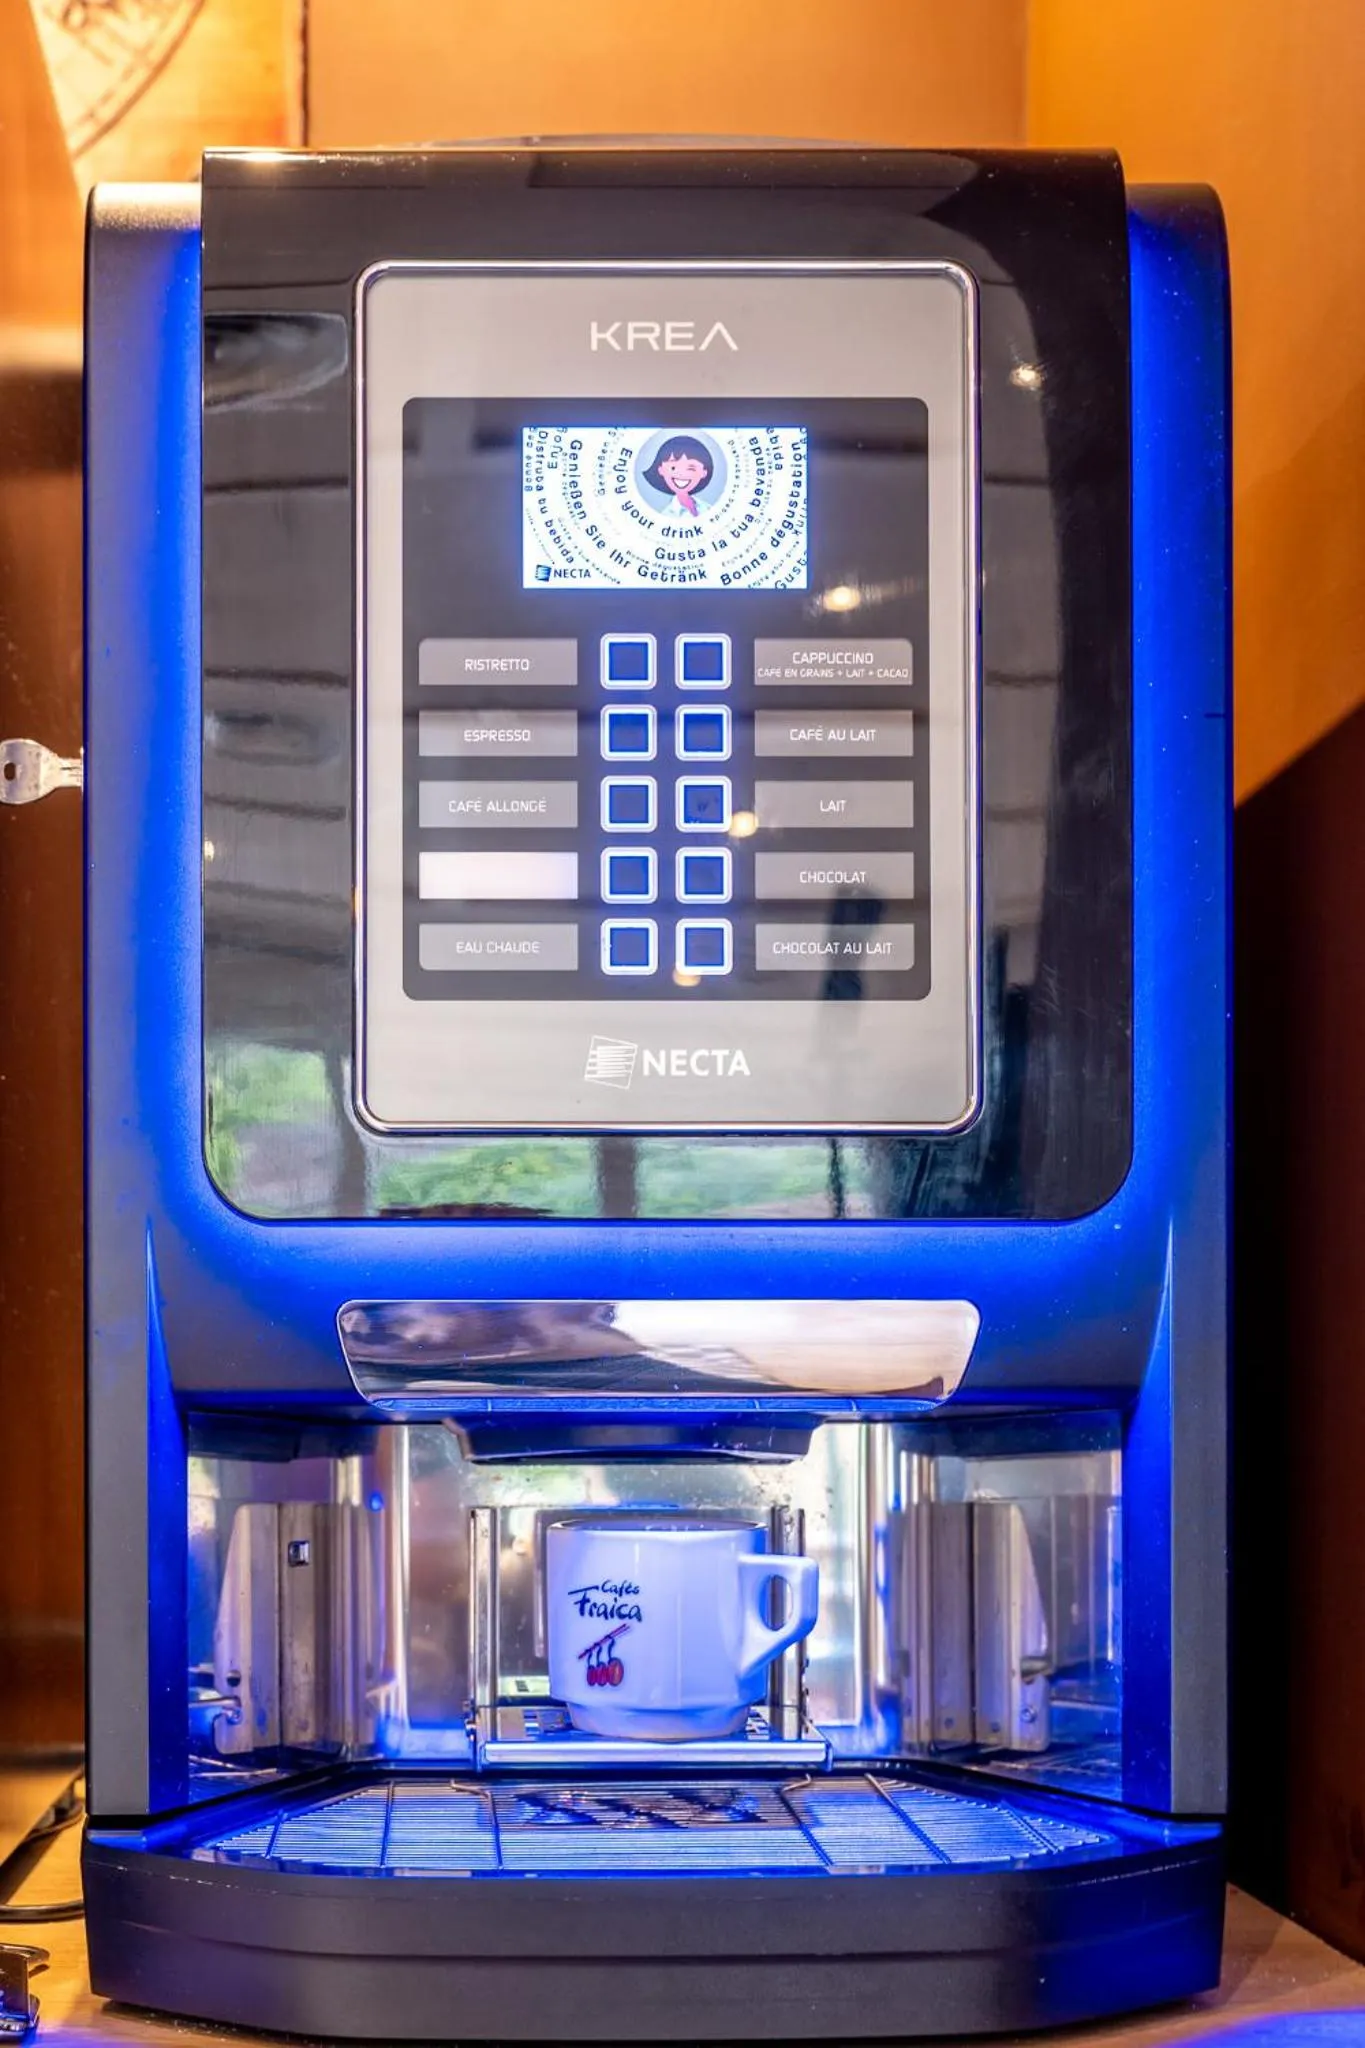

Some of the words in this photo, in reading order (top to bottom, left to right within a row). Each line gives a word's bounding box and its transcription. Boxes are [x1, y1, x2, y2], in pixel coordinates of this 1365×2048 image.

[590, 321, 739, 351] KREA
[612, 447, 633, 494] Enjoy
[654, 546, 706, 562] Gusta
[711, 540, 728, 552] la
[730, 514, 754, 539] tua
[748, 436, 766, 508] bevanda
[569, 439, 587, 520] Genießen
[585, 524, 606, 549] Sie
[609, 548, 631, 568] Ihr
[637, 564, 707, 583] Getränk
[621, 500, 655, 529] your
[720, 551, 768, 586] Bonne
[770, 442, 803, 548] dégustation
[661, 525, 704, 539] drink
[545, 519, 574, 563] bebida
[553, 568, 592, 579] NECTA
[774, 555, 807, 589] Gust
[464, 658, 530, 672] RISTRETTO
[792, 651, 874, 665] CAPPUCCINO
[784, 668, 798, 678] EN
[800, 668, 834, 678] GRAINS
[845, 668, 865, 678] LAIT
[876, 668, 909, 678] CACAO
[463, 729, 531, 742] ESPRESSO
[827, 729, 846, 741] AU
[849, 729, 877, 742] LAIT
[819, 799, 847, 812] LAIT
[799, 871, 867, 884] CHOCOLAT
[456, 941, 483, 954] EAU
[486, 941, 539, 954] CHAUDE
[772, 941, 840, 955] CHOCOLAT
[842, 941, 862, 955] AU
[865, 941, 893, 955] LAIT
[643, 1049, 751, 1076] NECTA
[567, 1585, 643, 1622] Fraica
